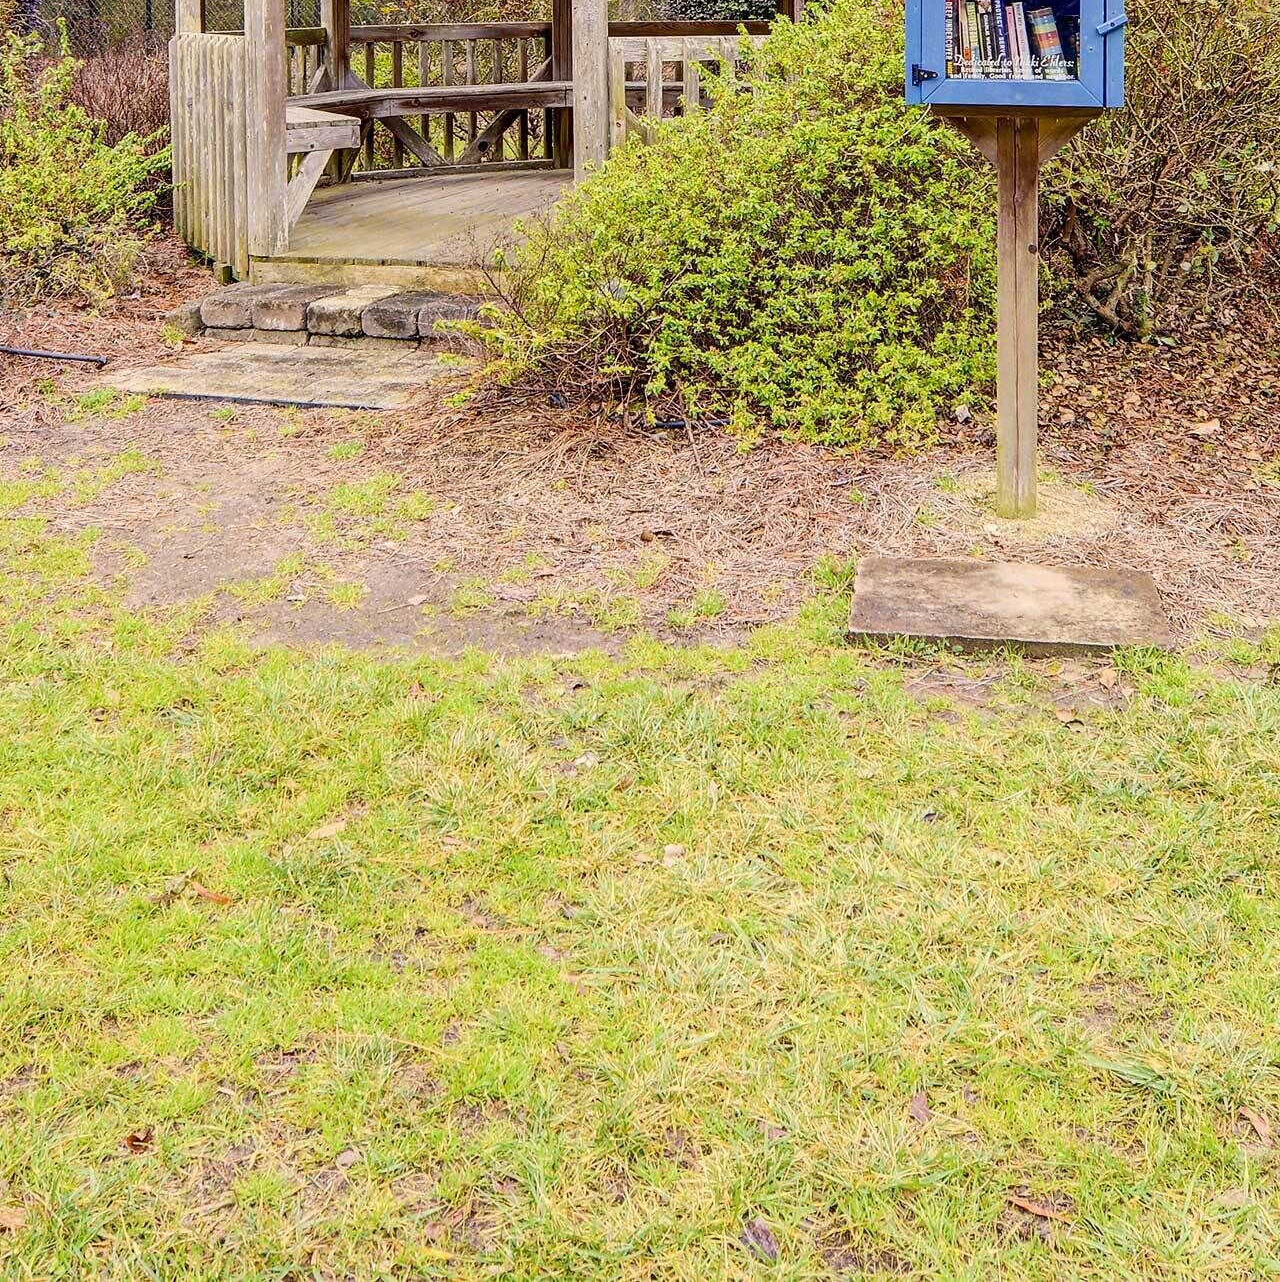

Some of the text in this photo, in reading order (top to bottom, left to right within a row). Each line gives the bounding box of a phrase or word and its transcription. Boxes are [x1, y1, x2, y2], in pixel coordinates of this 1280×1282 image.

[945, 1, 953, 18] DEEP
[994, 0, 1003, 28] PROTECT
[945, 19, 953, 60] UNDERCOVER
[953, 53, 1004, 67] Dedicated
[1002, 58, 1013, 67] to
